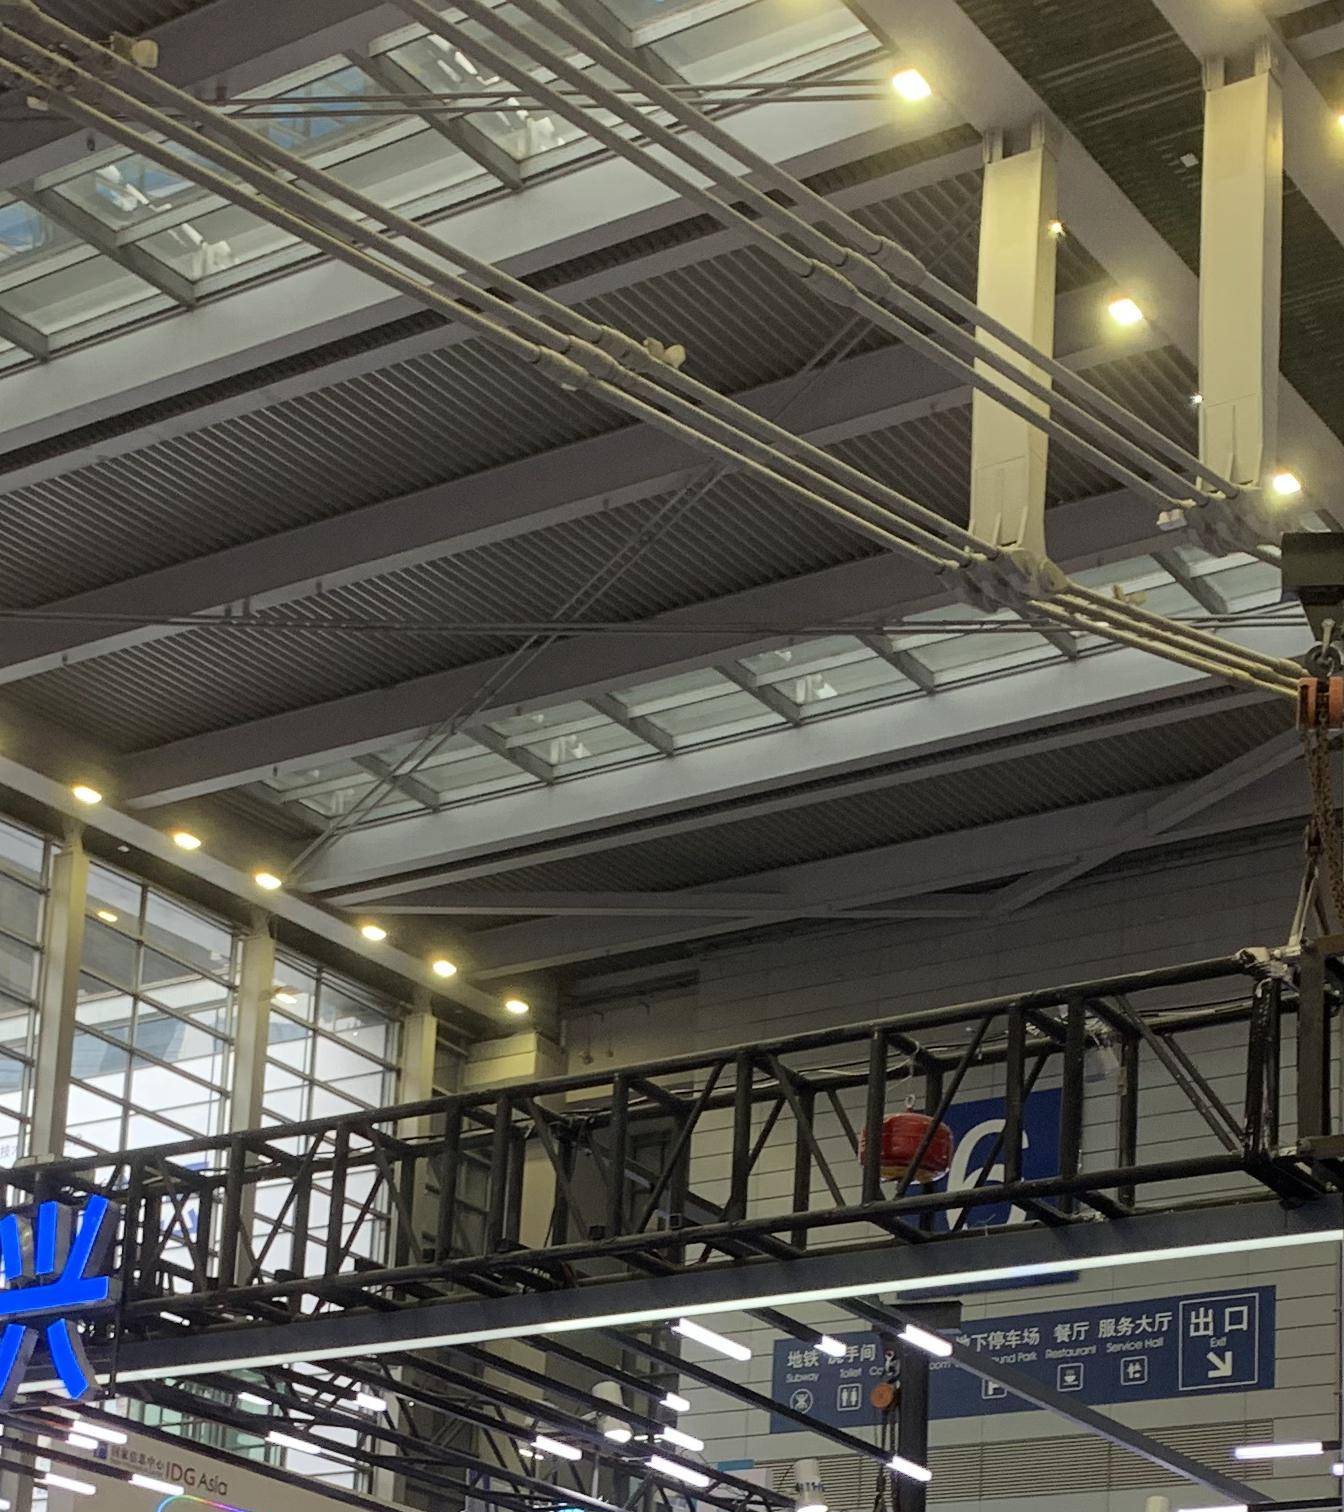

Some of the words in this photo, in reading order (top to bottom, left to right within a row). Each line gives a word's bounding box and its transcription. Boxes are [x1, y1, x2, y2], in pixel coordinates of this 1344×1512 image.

[1053, 1321, 1090, 1343] 餐厅
[1098, 1311, 1173, 1339] 服务大厅
[1189, 1305, 1249, 1337] 出口
[1045, 1344, 1098, 1360] Restaurant
[1106, 1340, 1143, 1353] Service
[1144, 1336, 1165, 1349] Hall
[1210, 1336, 1227, 1348] Exit
[786, 1349, 821, 1369] 地铁
[785, 1371, 820, 1384] Subway
[839, 1367, 863, 1380] Toilet
[166, 1460, 197, 1487] IDG
[197, 1472, 229, 1496] Asia
